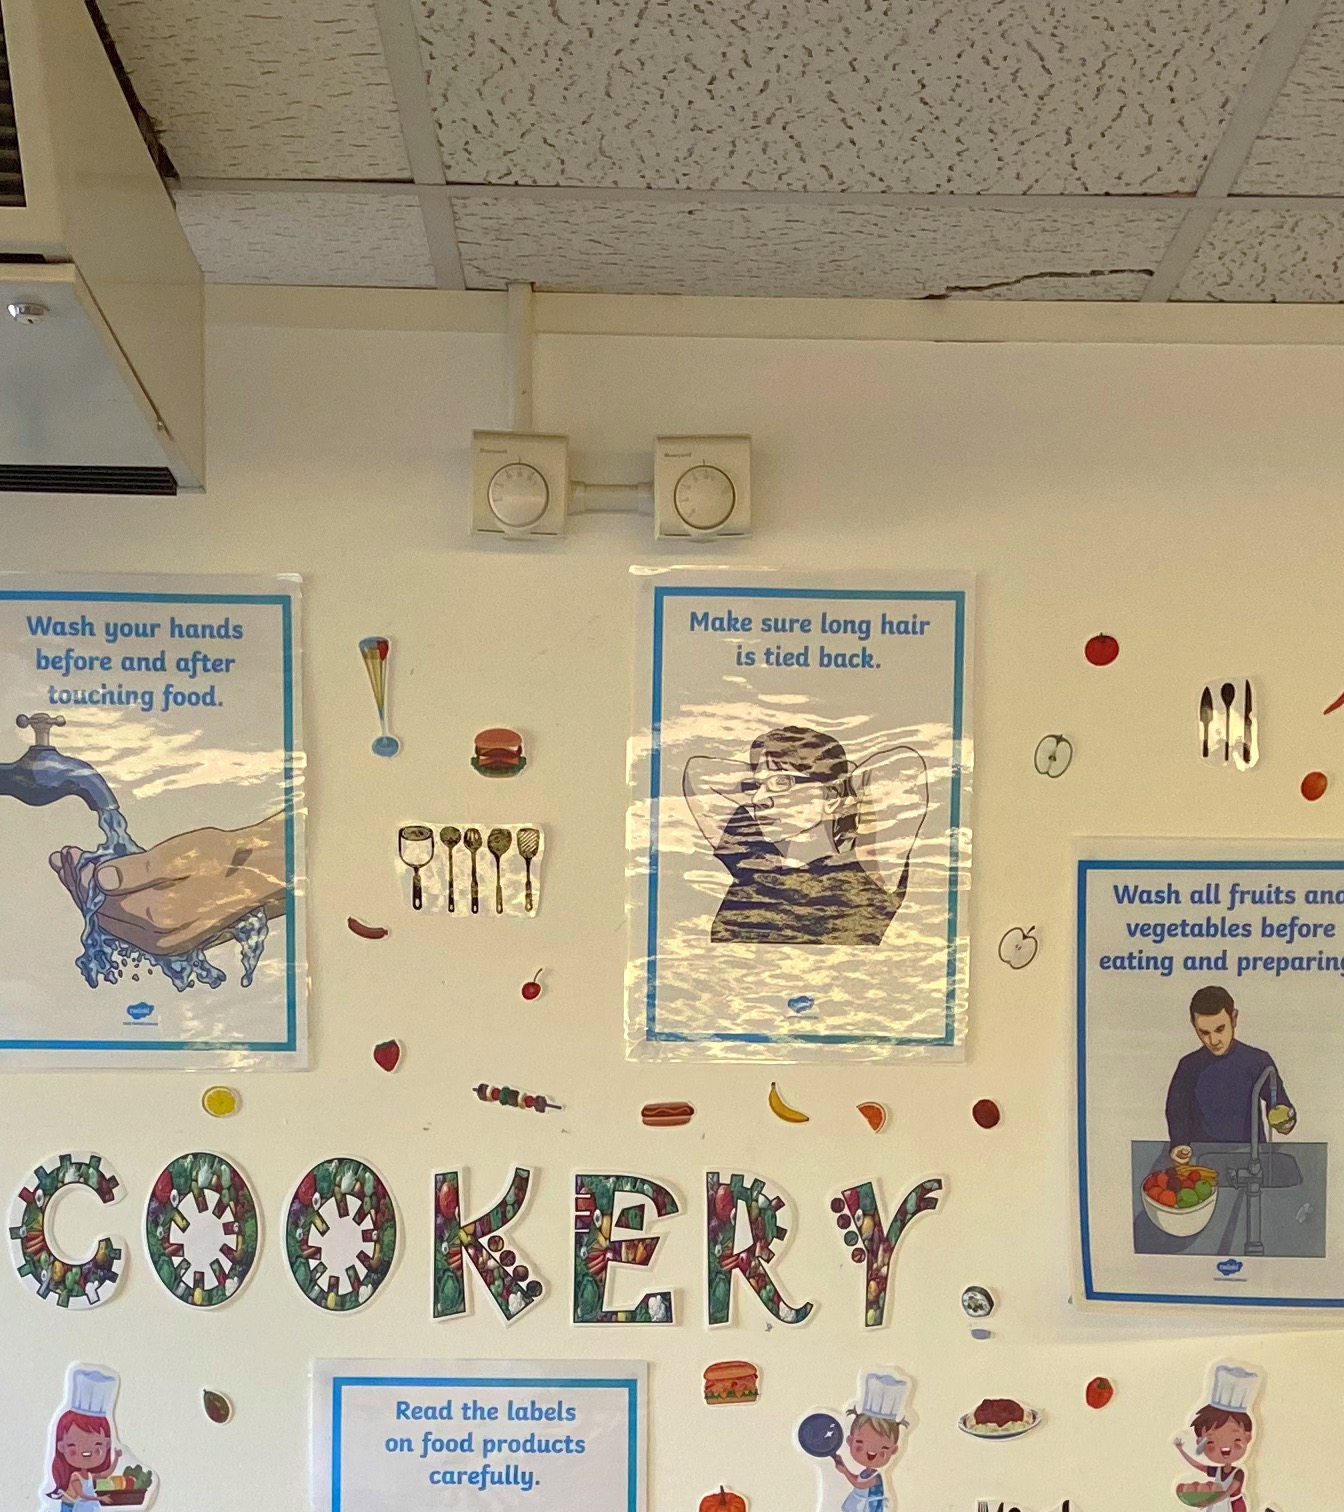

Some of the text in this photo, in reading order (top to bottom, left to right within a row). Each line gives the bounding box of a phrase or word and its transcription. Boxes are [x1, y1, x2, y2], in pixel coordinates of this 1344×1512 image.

[27, 615, 244, 644] Wash your hands
[690, 609, 930, 641] Make sure long hair
[36, 647, 236, 679] before and after
[736, 645, 882, 669] is tied back.
[48, 683, 223, 712] touching food.
[1113, 883, 1181, 905] Wash
[1190, 883, 1221, 905] all
[1227, 883, 1296, 911] fruits
[1126, 916, 1336, 944] vegetables before
[1099, 949, 1174, 976] eating
[1183, 949, 1228, 971] and
[8, 1152, 943, 1330] COOKERY
[396, 1399, 577, 1422] Read the labels
[385, 1431, 586, 1459] on food products
[429, 1464, 540, 1491] carefully.
